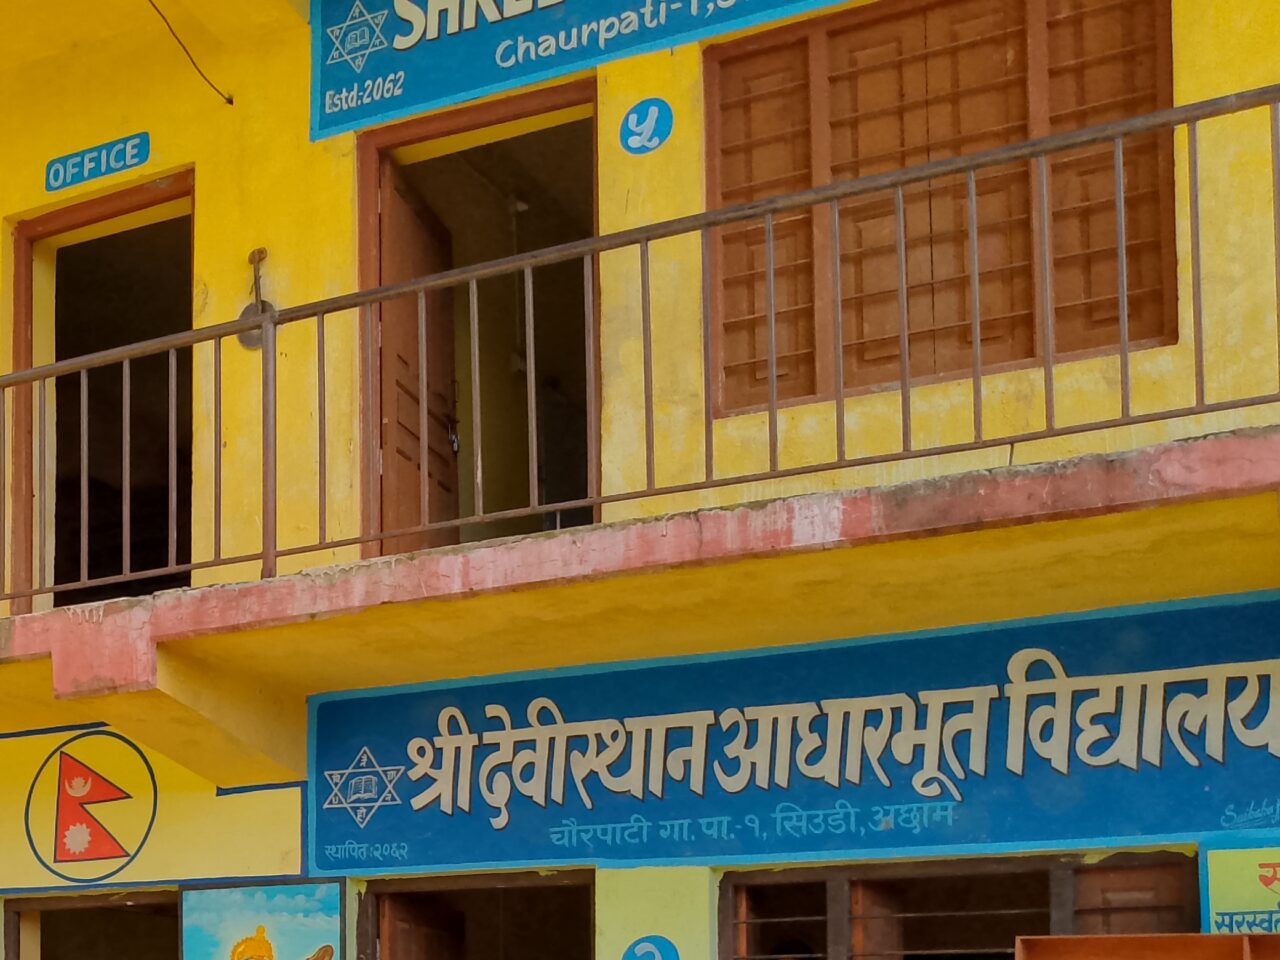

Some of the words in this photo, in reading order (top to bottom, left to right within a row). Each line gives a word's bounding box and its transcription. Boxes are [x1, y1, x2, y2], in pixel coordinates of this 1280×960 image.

[48, 138, 141, 188] OFFICE
[406, 706, 480, 815] श्री
[478, 696, 716, 830] देवीस्थान
[713, 684, 1000, 802] आधारभूत
[1004, 647, 1280, 776] विद्यालय
[549, 813, 653, 848] चौरपाटी
